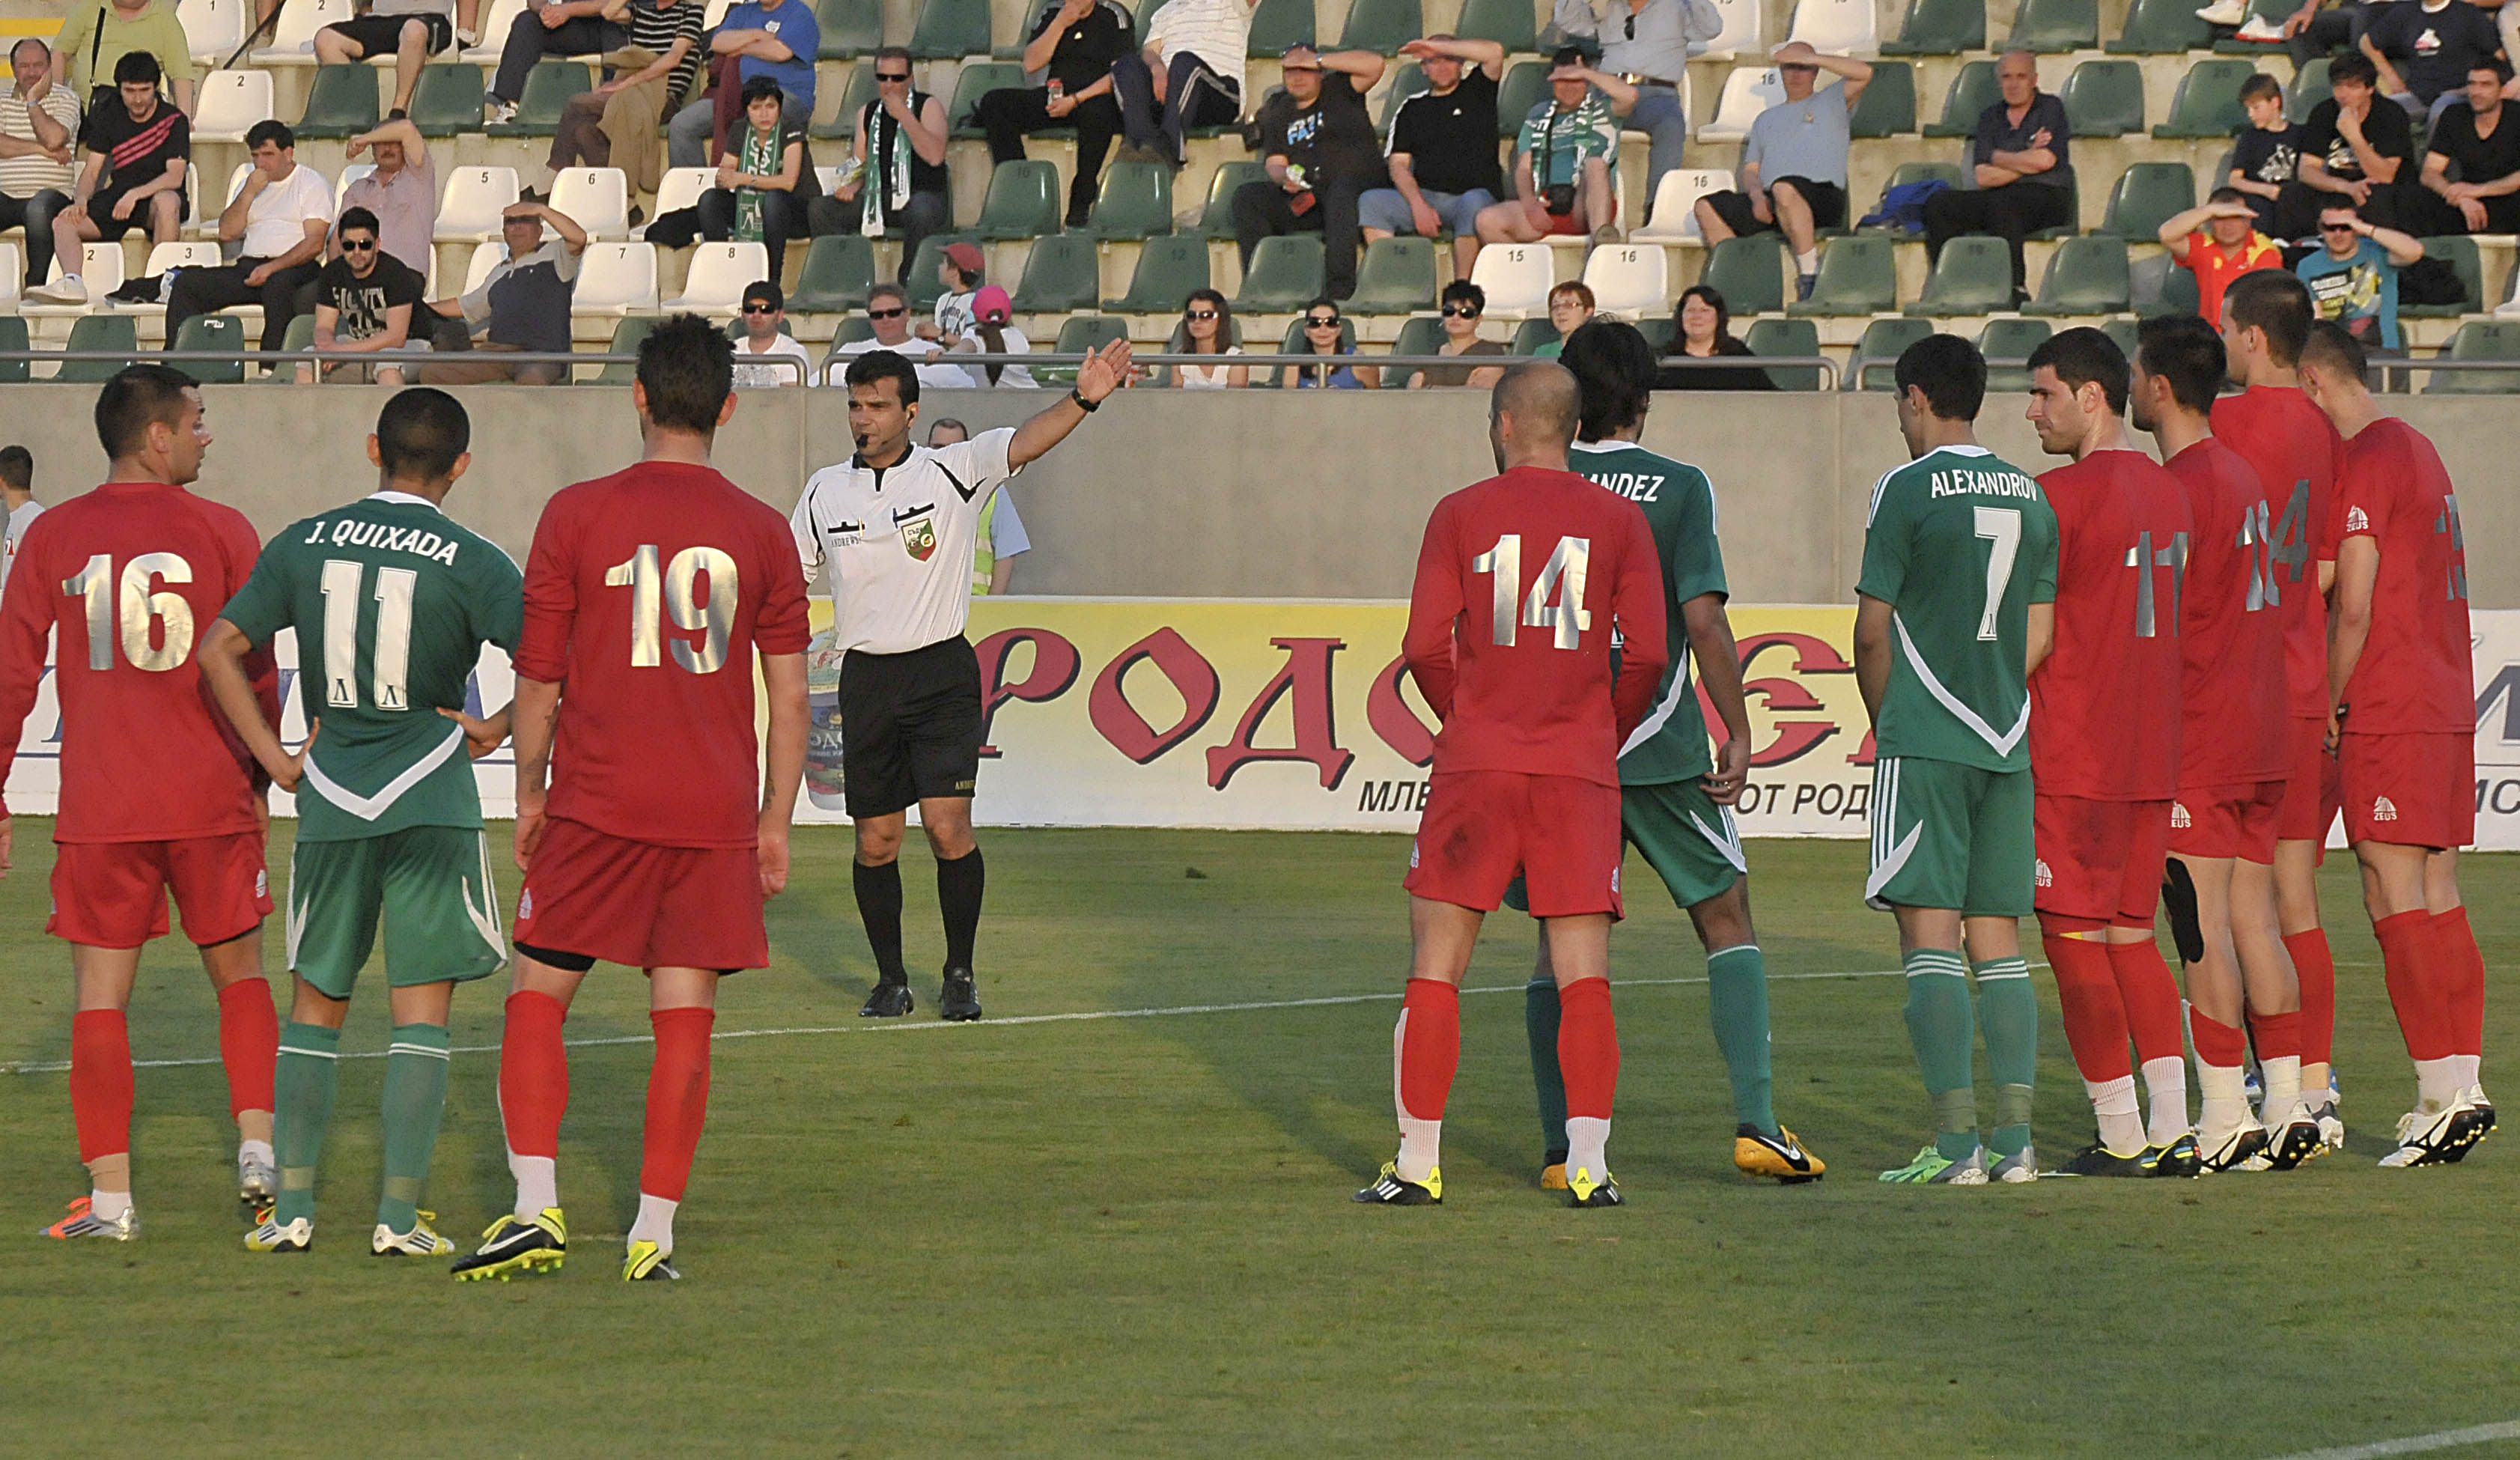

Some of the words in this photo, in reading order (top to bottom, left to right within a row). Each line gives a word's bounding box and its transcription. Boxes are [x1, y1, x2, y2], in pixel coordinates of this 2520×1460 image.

[209, 1, 216, 11] 1
[317, 1, 326, 12] 2
[237, 76, 245, 88] 2
[1762, 74, 1775, 86] 16
[481, 172, 489, 184] 5
[588, 173, 596, 186] 6
[696, 174, 704, 186] 7
[1693, 176, 1708, 189] 16
[86, 249, 95, 262] 2
[184, 246, 193, 260] 3
[618, 248, 627, 260] 7
[727, 247, 736, 259] 8
[1508, 249, 1525, 263] 15
[1620, 250, 1637, 264] 16
[1931, 469, 2037, 502] ALEXANDROV
[2346, 520, 2370, 533] ZEUS
[305, 522, 326, 544] J.
[331, 518, 460, 567] QUIXADA
[1973, 506, 2021, 642] 7
[2123, 531, 2189, 638] 11
[1473, 534, 1592, 651] 14
[62, 552, 194, 672] 16
[605, 544, 738, 675] 19
[320, 559, 417, 711] 11
[1358, 781, 1431, 812] МЛЕ
[1735, 783, 1786, 815] ОТ
[1792, 783, 1871, 821] РОД
[2373, 810, 2398, 821] ZEUS
[2171, 818, 2192, 829] EUS
[2035, 878, 2053, 888] EUS
